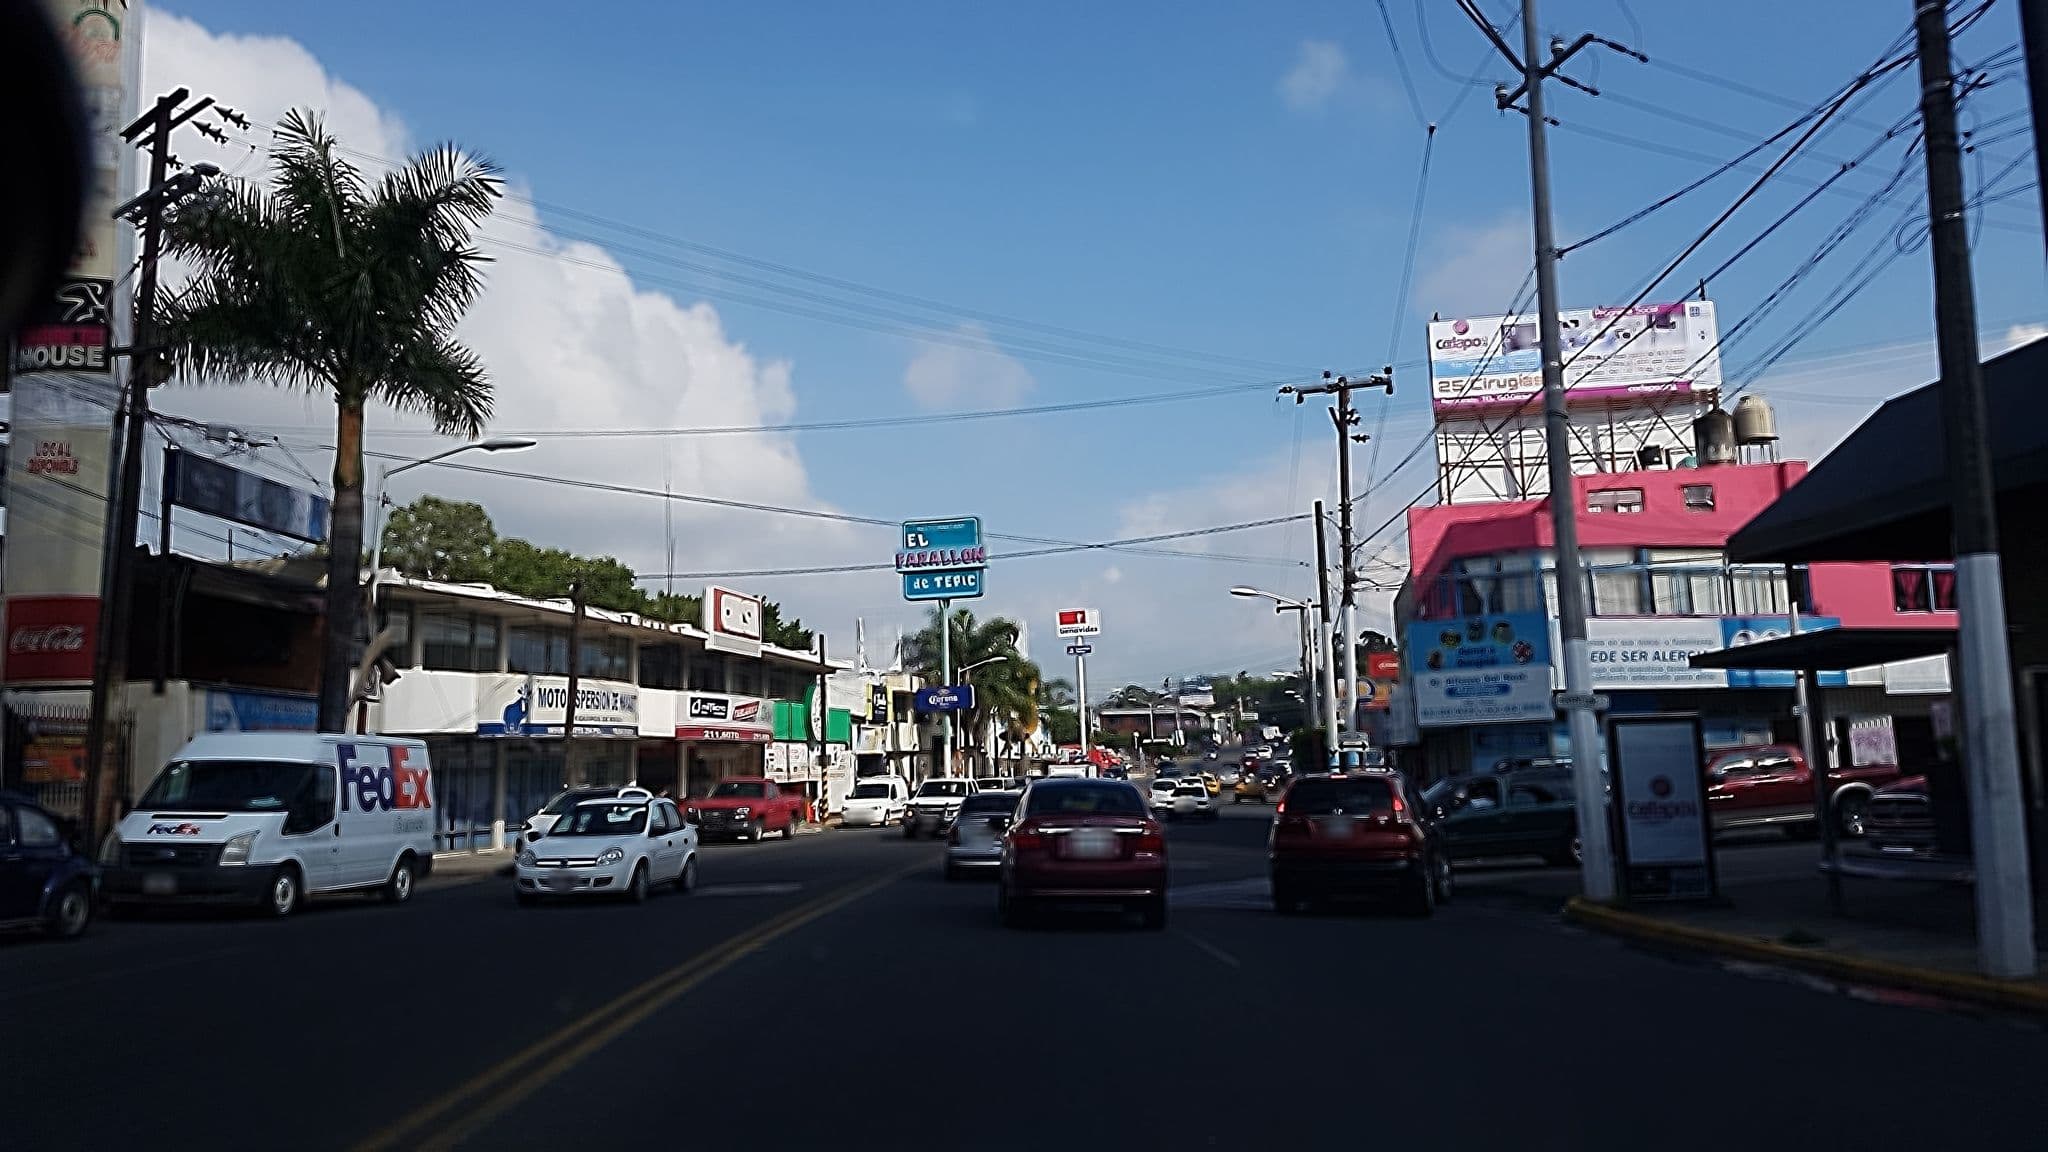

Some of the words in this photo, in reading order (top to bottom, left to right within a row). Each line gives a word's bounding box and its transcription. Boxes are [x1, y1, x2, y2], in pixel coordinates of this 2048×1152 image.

[1438, 380, 1464, 393] 25
[907, 533, 929, 547] EL
[913, 578, 929, 589] de
[934, 574, 976, 588] TEPIC
[1621, 651, 1649, 663] SER
[928, 694, 958, 705] Corona
[337, 743, 432, 813] FedEx
[147, 822, 201, 836] FedEx
